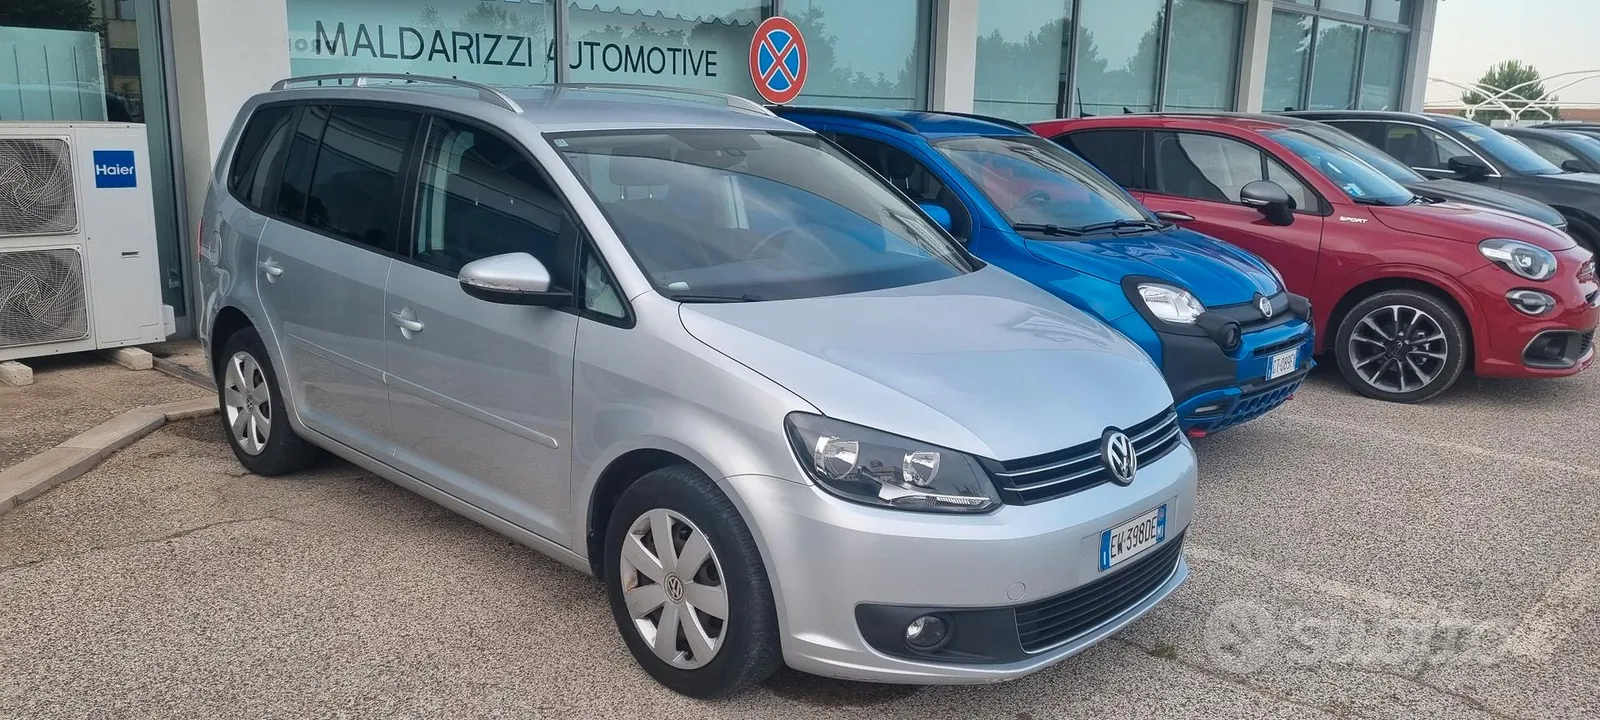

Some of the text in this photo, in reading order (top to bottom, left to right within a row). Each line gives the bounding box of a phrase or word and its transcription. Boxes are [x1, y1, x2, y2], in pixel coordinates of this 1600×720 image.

[315, 20, 717, 77] MALDARIZZI AUTOMOTIVE
[95, 163, 134, 176] Haier
[1339, 215, 1369, 224] SPORT
